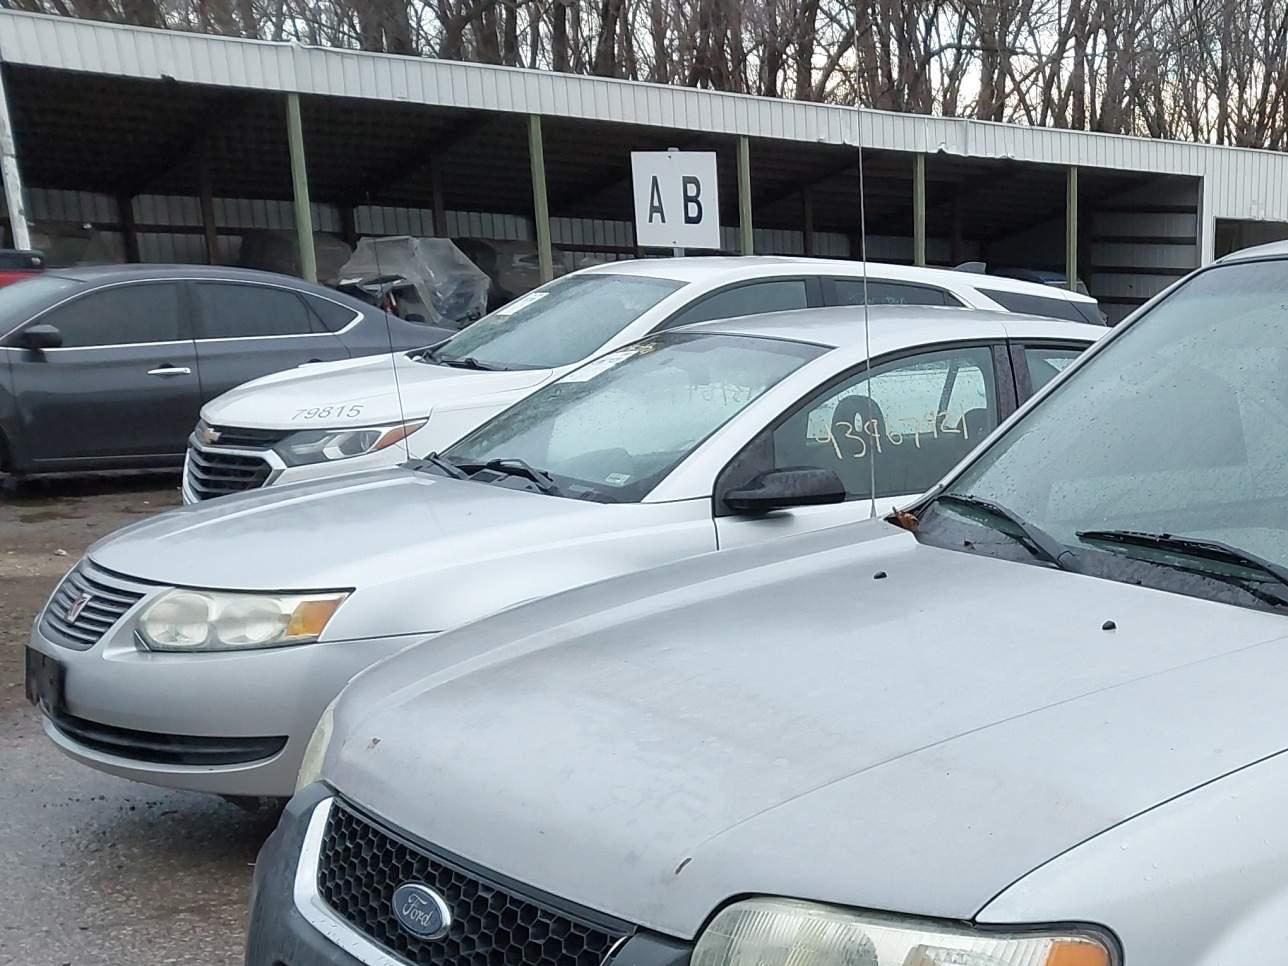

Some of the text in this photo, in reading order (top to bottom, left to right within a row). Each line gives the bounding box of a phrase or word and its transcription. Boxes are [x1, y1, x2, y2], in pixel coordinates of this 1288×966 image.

[648, 175, 703, 225] A B
[291, 404, 365, 420] 79815
[402, 893, 433, 927] Ford
